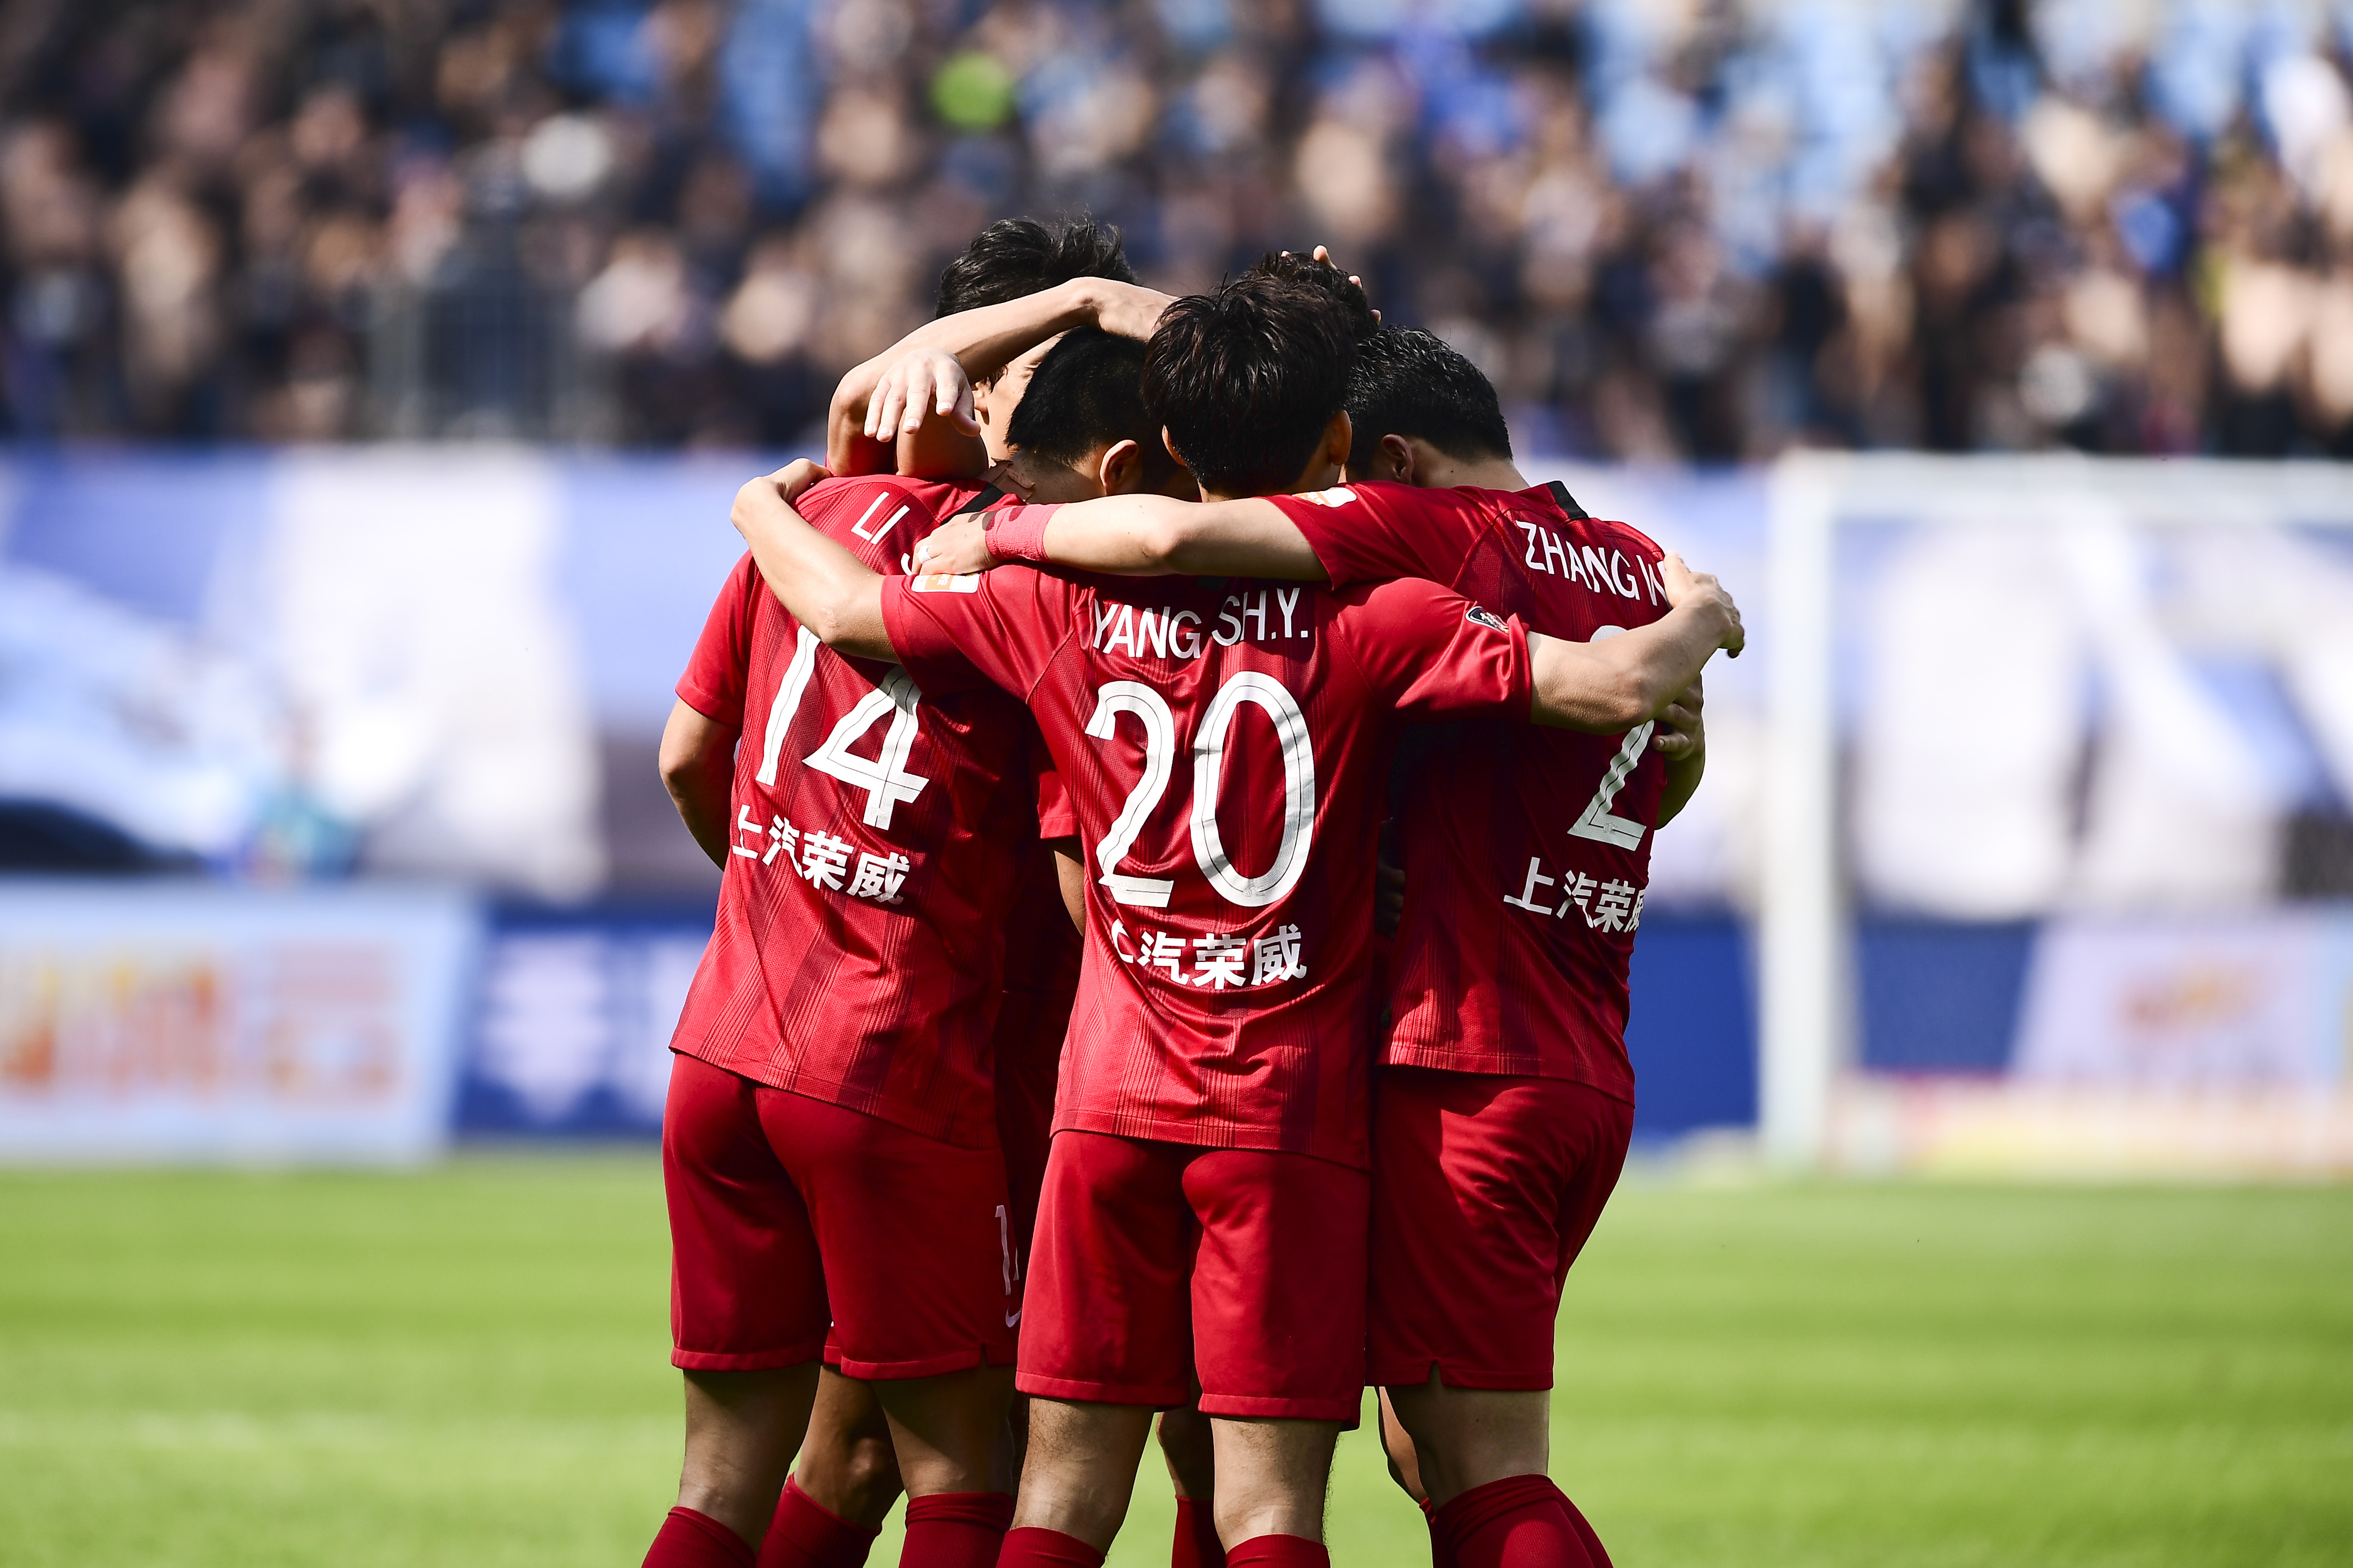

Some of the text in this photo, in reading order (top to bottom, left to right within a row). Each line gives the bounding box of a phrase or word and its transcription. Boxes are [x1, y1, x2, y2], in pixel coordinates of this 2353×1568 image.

[851, 491, 910, 544] LI
[1516, 520, 1641, 600] ZHANG
[1092, 587, 1308, 659] YANG SH.Y.
[755, 624, 929, 831] 14
[1084, 671, 1316, 907] 20
[732, 804, 911, 905] 上汽荣威
[994, 1204, 1020, 1296] 1
